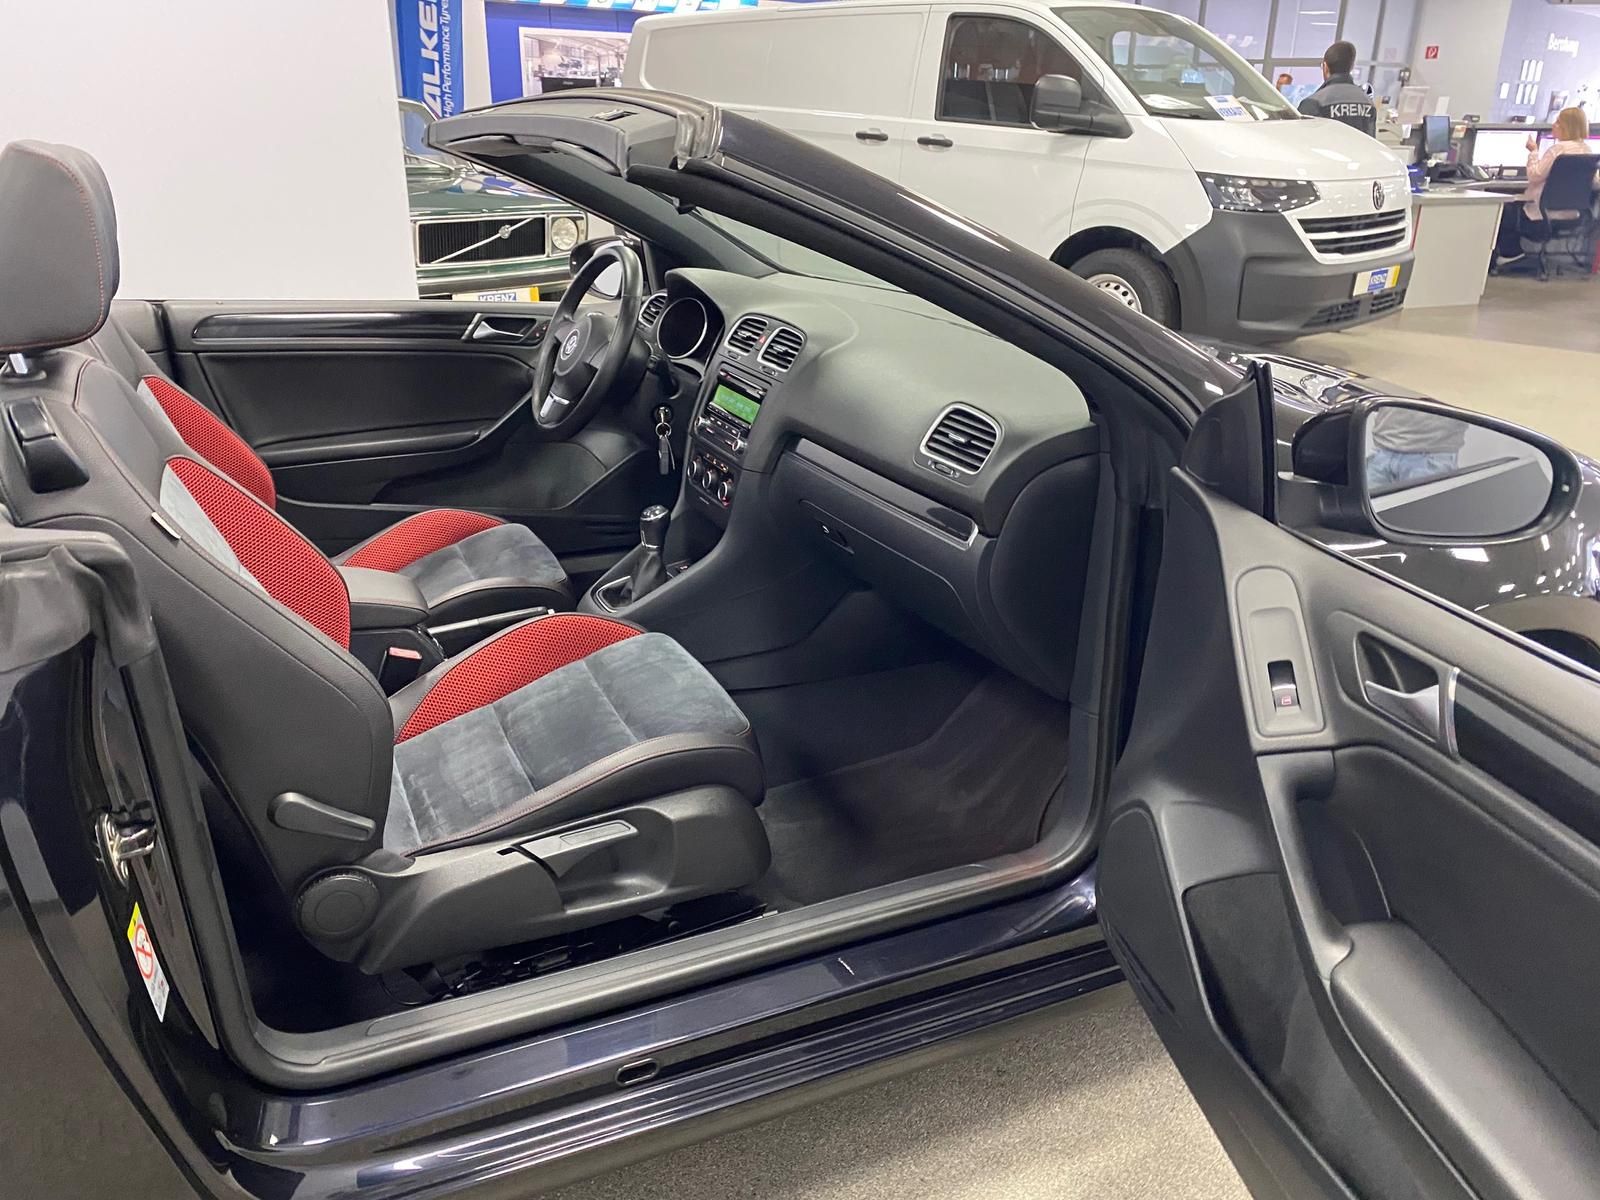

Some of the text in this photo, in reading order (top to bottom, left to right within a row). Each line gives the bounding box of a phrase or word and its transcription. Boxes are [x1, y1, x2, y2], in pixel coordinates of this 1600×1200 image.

[439, 0, 451, 25] Tyre
[418, 0, 442, 119] ALKE
[441, 26, 452, 93] Performance
[1330, 103, 1372, 118] KRENZ
